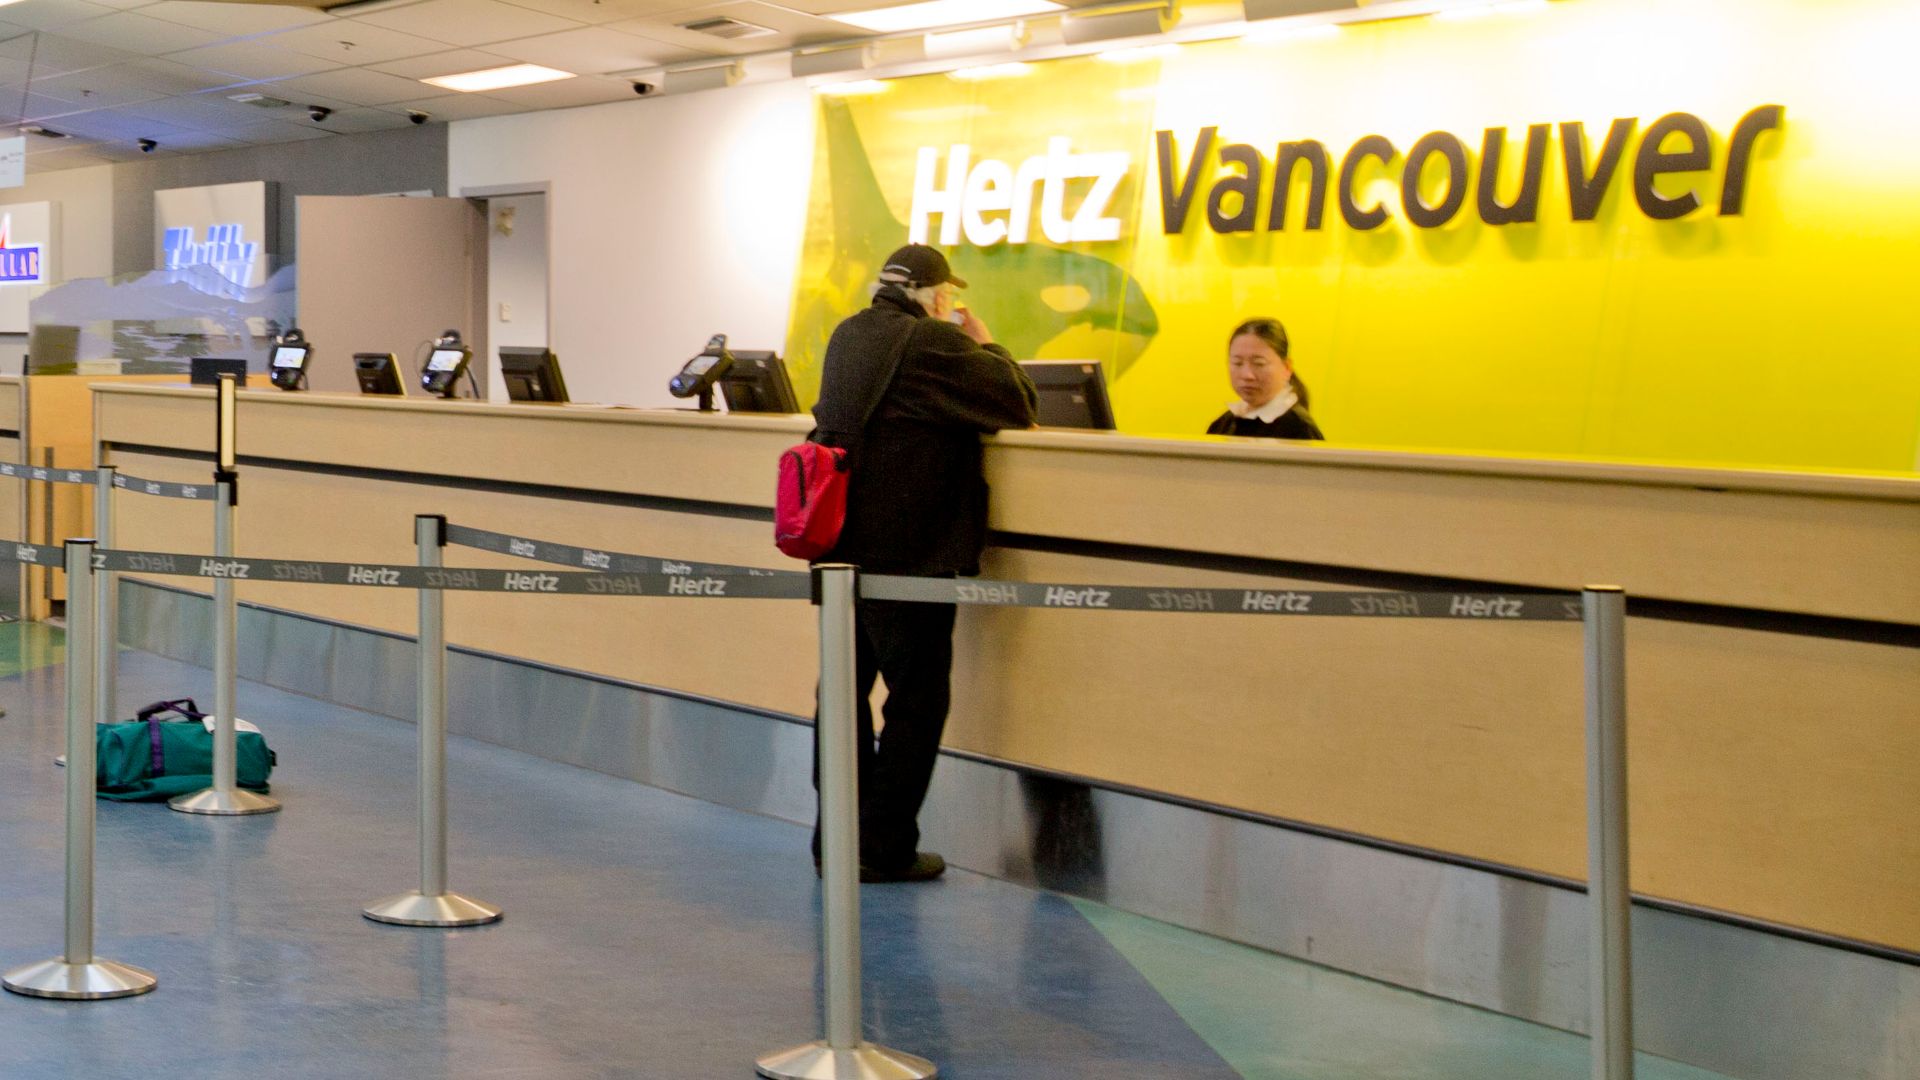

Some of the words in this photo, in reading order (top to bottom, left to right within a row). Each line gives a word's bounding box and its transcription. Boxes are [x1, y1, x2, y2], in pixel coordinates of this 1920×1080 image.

[908, 136, 1130, 246] Hertz
[1155, 104, 1784, 236] Vancouver
[509, 538, 536, 557] Hertz
[582, 549, 611, 569] Hertz
[200, 559, 249, 578] Hertz
[349, 566, 400, 585] Hertz
[503, 572, 560, 592] Hertz
[668, 576, 727, 595] Hertz
[1045, 586, 1111, 607] Hertz
[1242, 591, 1312, 612] Hertz
[1450, 595, 1523, 617] Hertz
